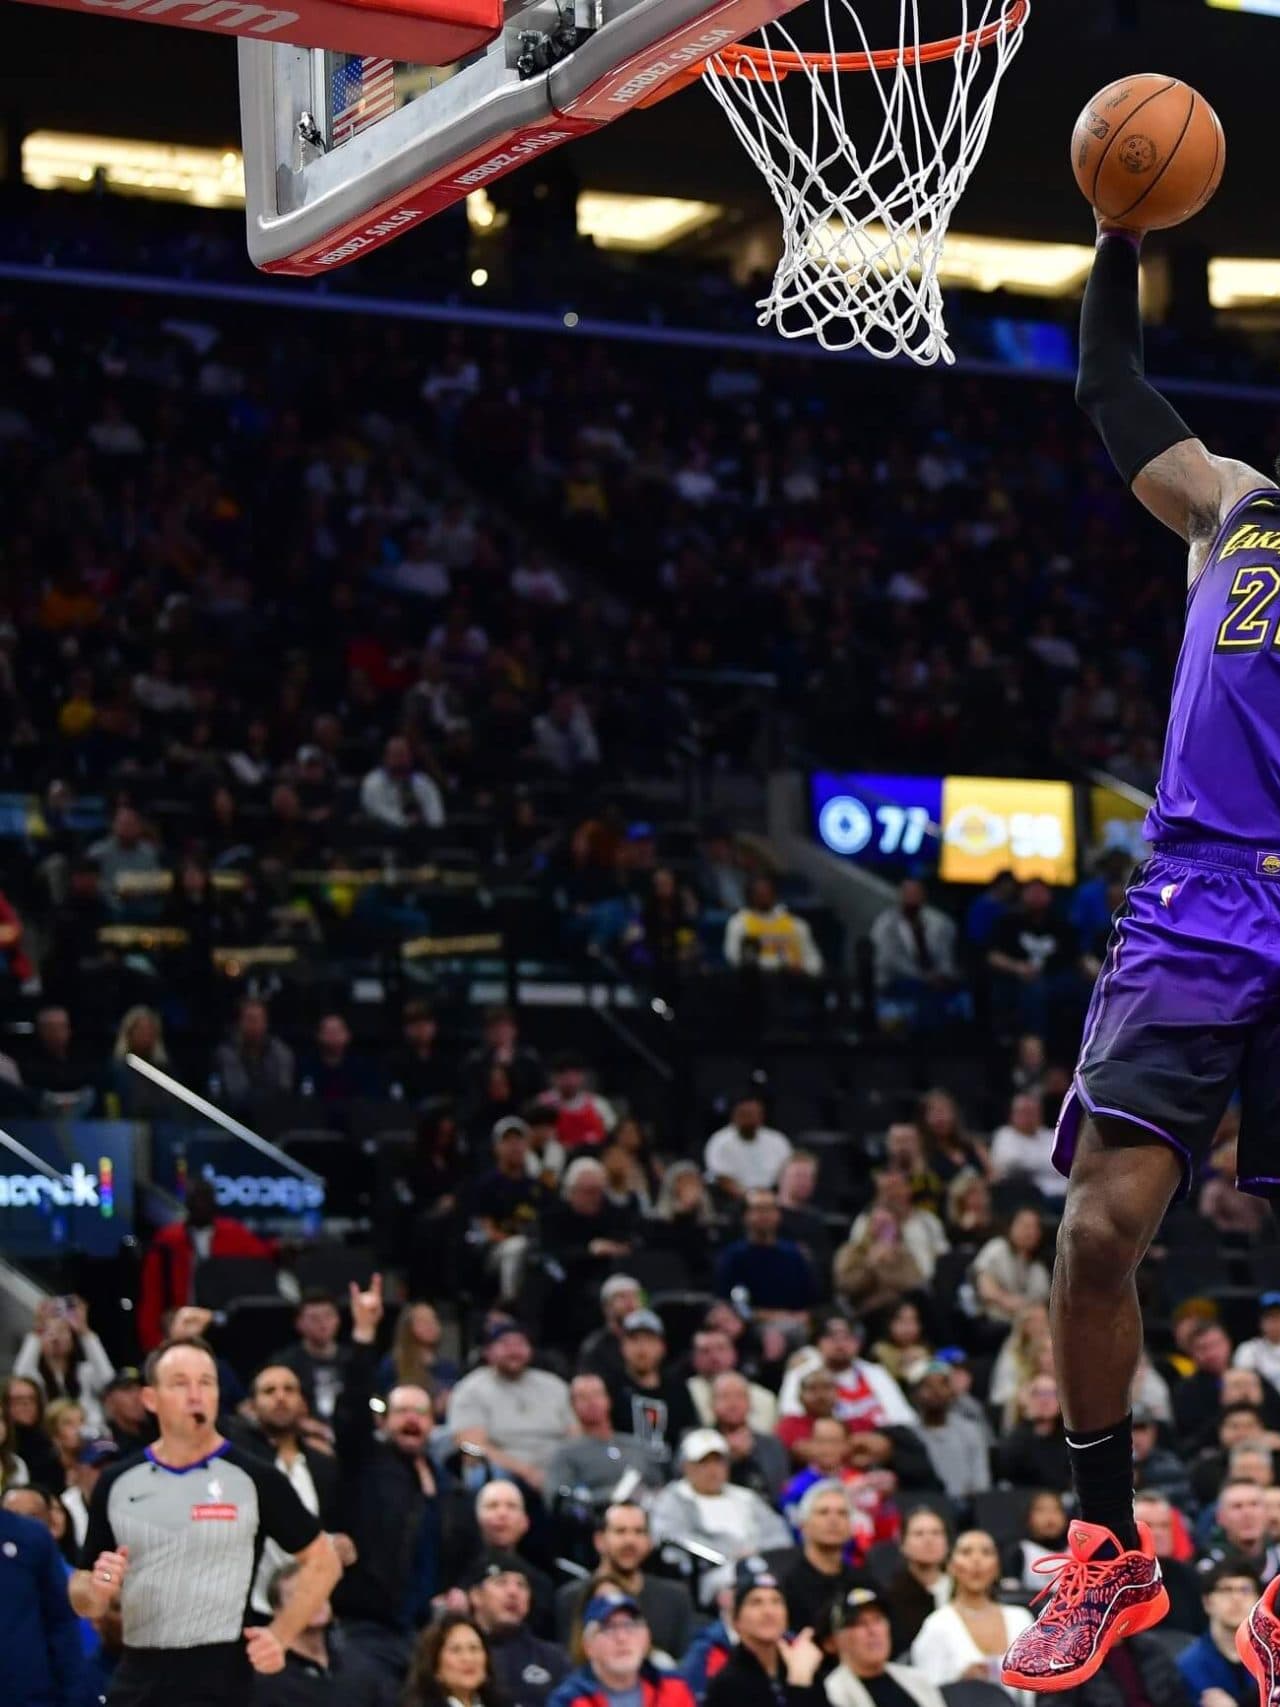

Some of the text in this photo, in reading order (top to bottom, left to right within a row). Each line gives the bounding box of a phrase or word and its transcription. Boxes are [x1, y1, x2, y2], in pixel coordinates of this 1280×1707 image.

[608, 29, 736, 102] HERDEZ SALSA
[454, 131, 573, 185] HERDEZ SALSA
[314, 208, 423, 265] HERDEZ SALSA
[876, 806, 929, 854] 77
